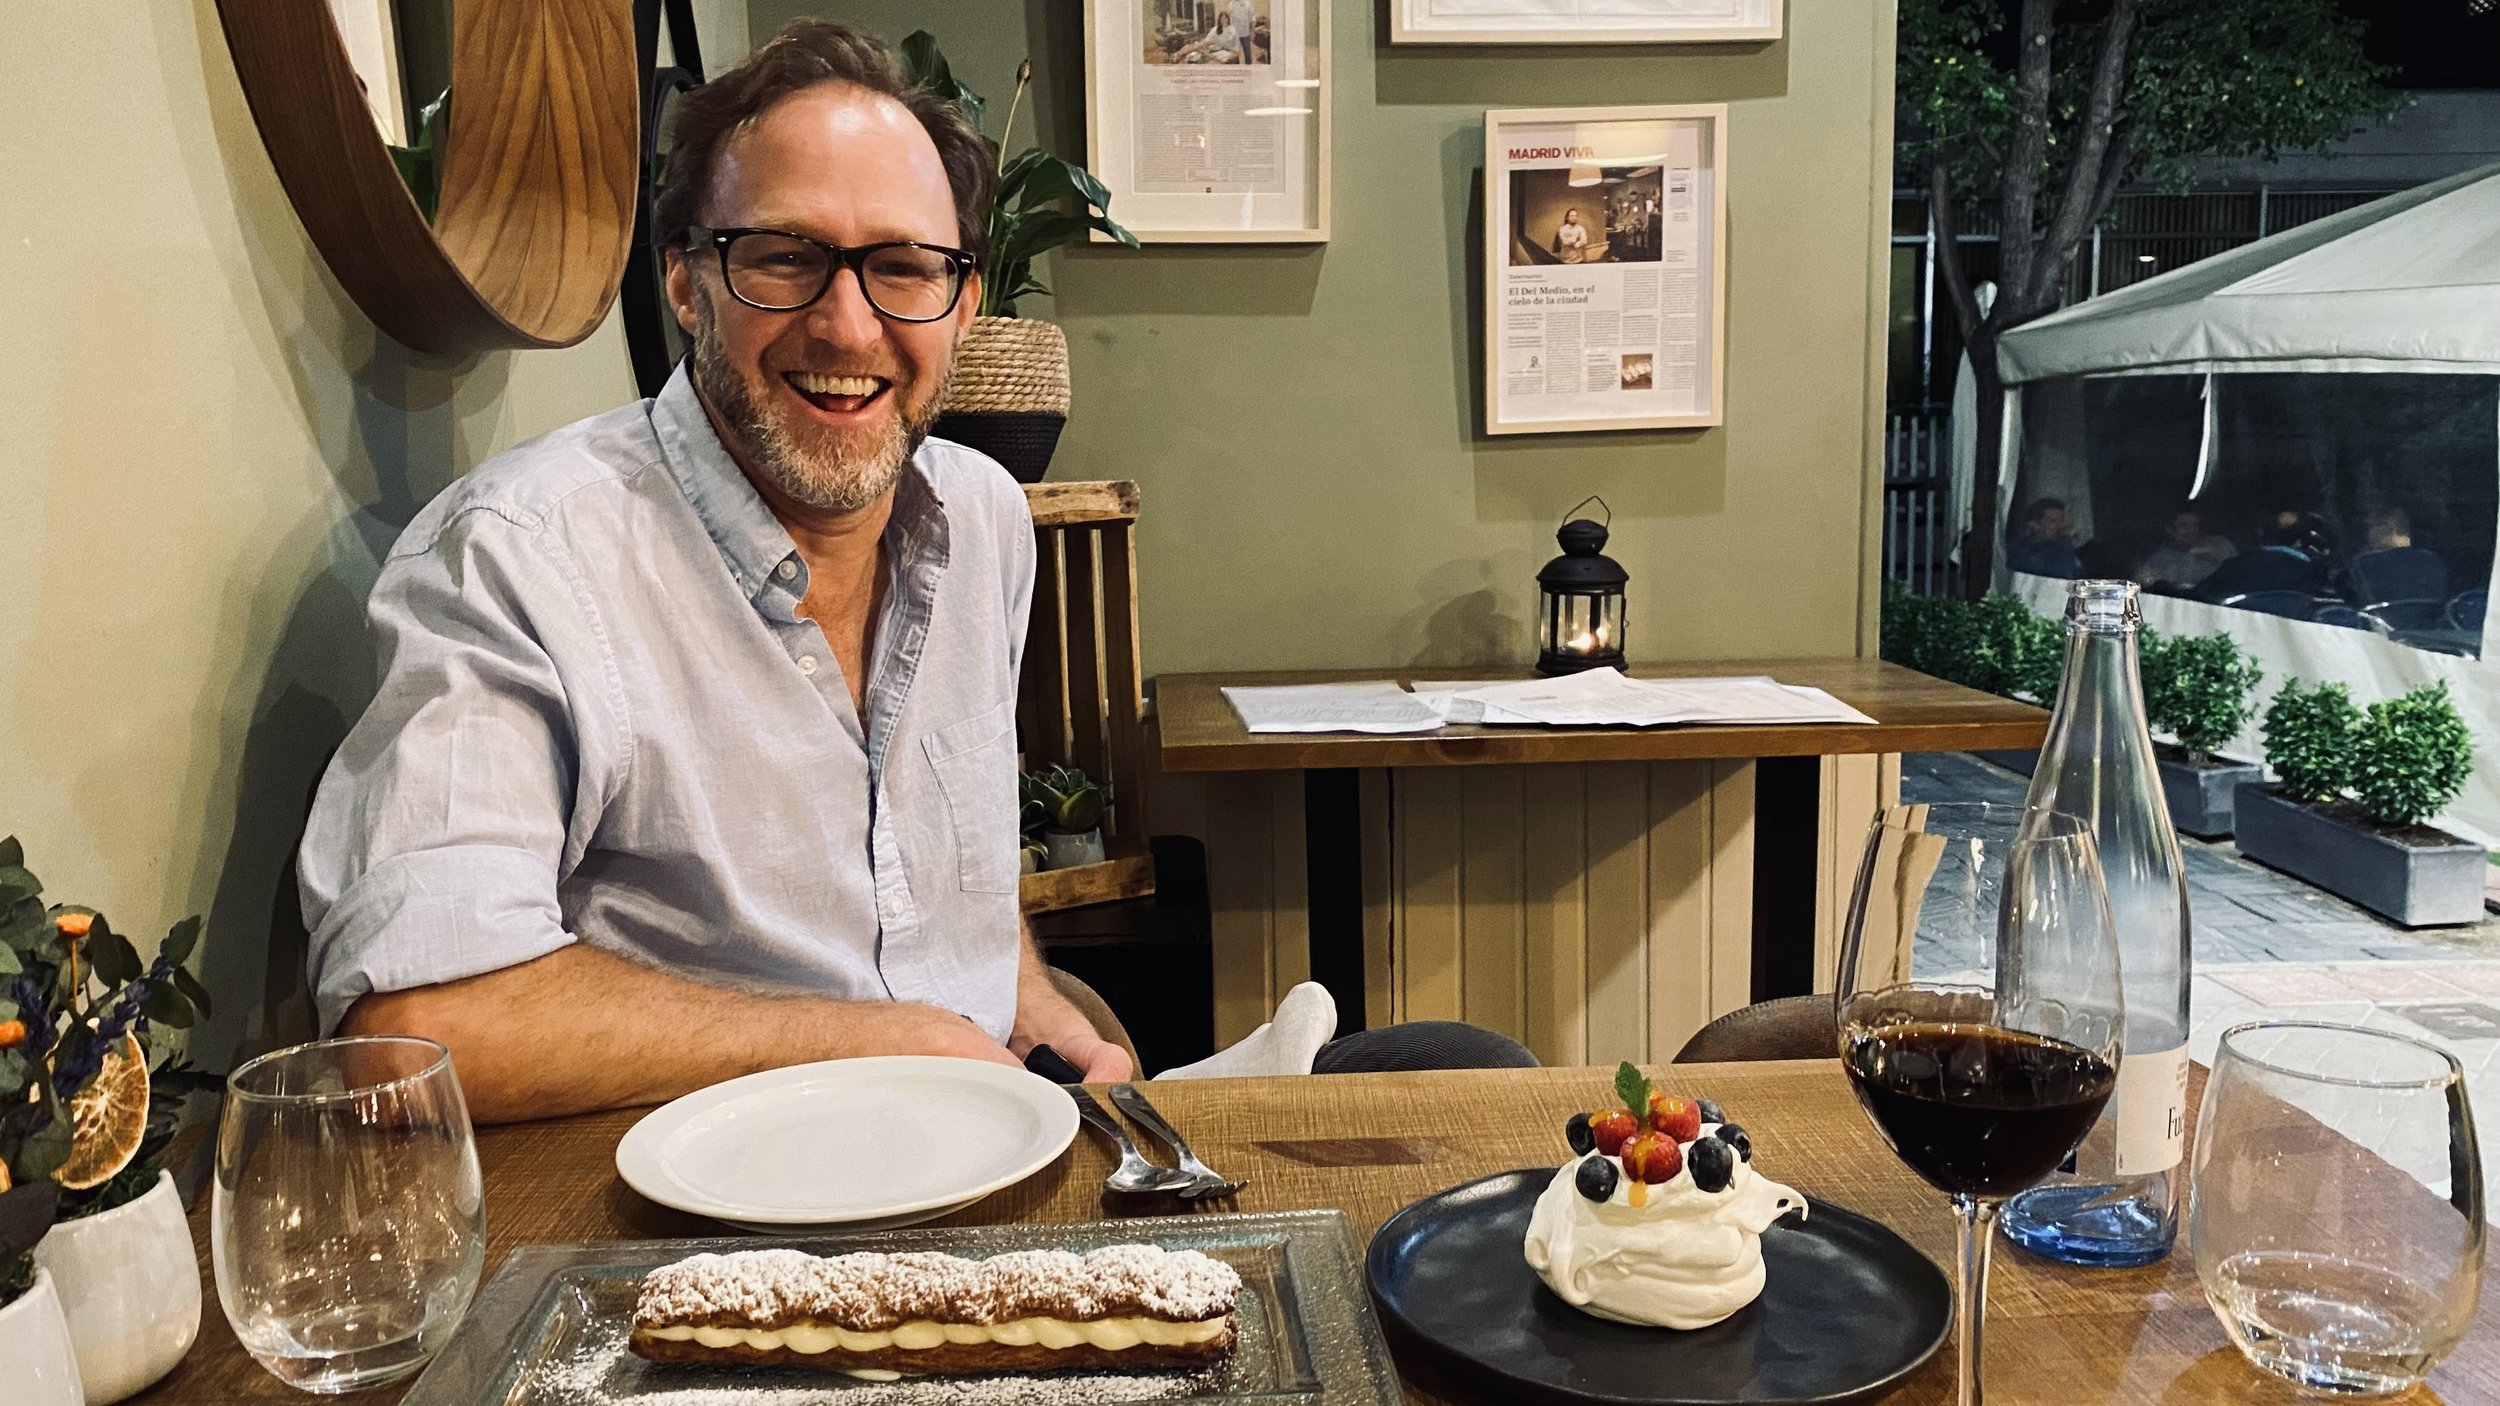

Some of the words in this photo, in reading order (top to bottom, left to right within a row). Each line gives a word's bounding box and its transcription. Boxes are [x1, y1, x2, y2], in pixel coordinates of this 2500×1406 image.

[1508, 147, 1561, 159] MADRID
[1508, 287, 1519, 296] El
[1521, 287, 1537, 295] Del
[1539, 286, 1571, 295] Medio,
[1586, 285, 1595, 293] el
[1508, 298, 1532, 306] cielo
[1533, 296, 1544, 305] de
[1545, 296, 1555, 304] la
[1556, 295, 1588, 304] ciudad
